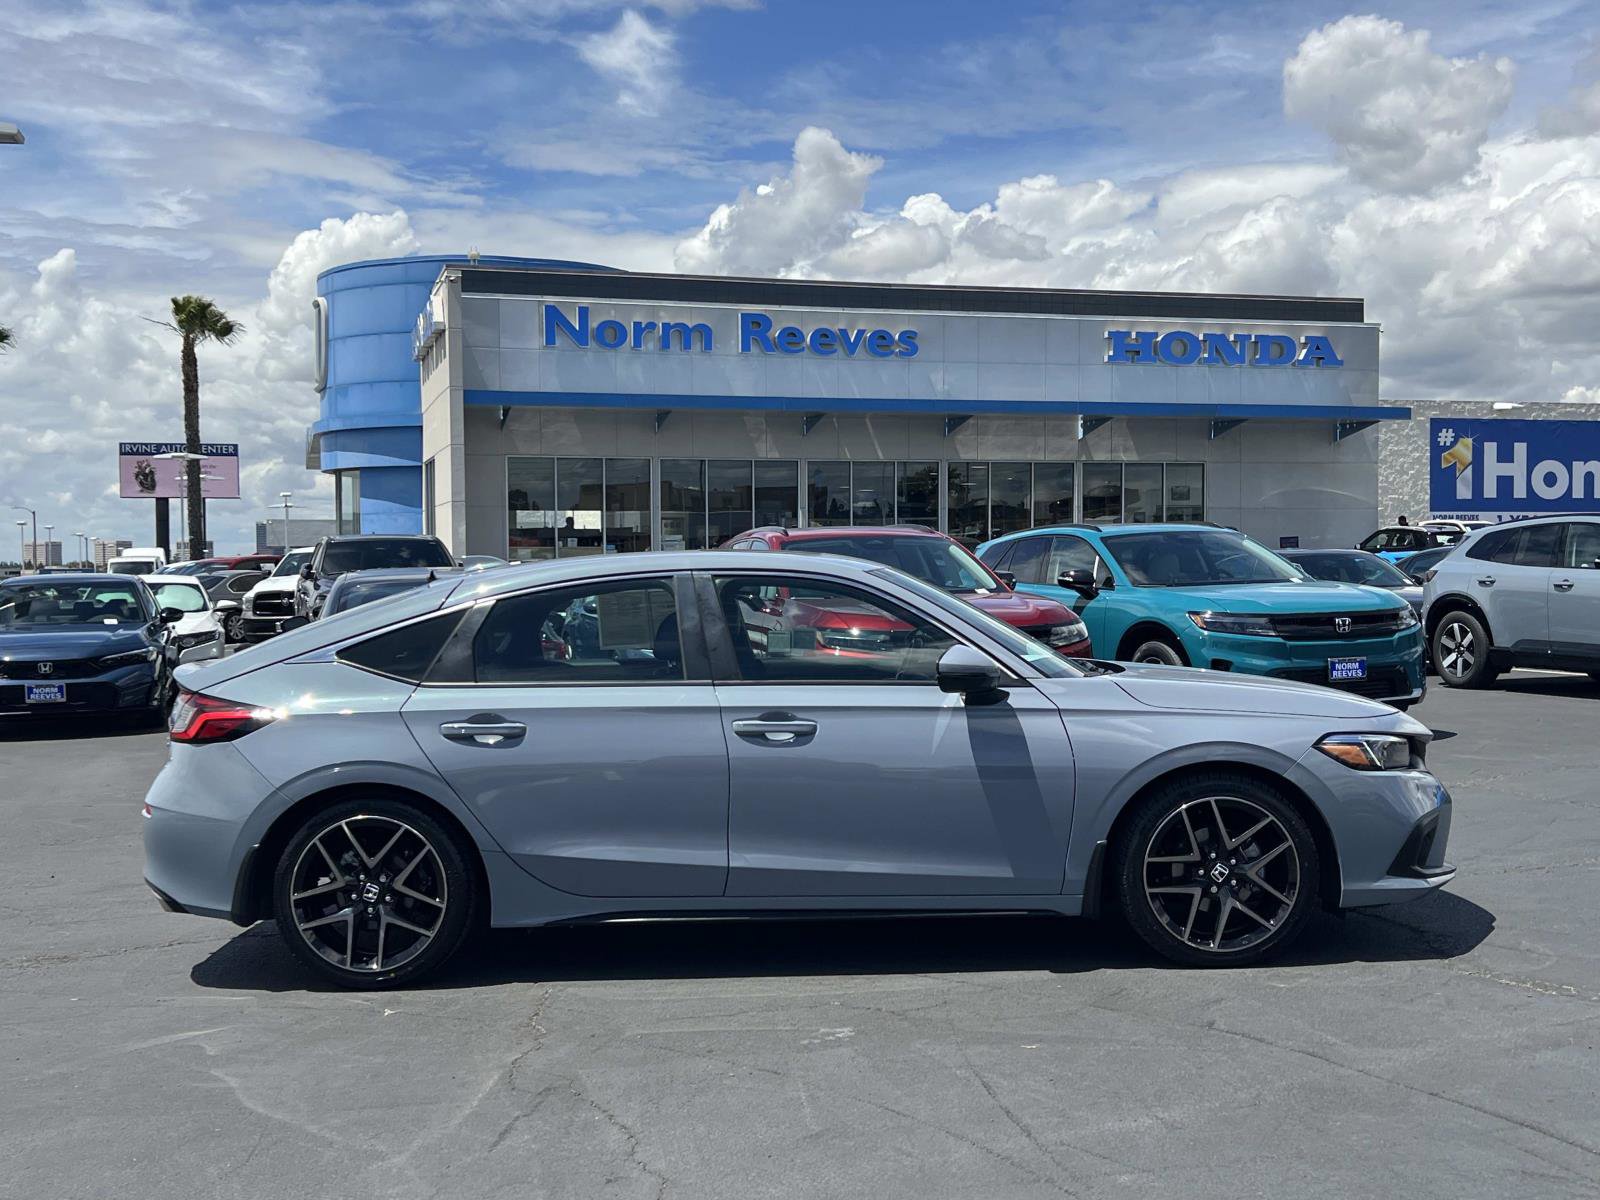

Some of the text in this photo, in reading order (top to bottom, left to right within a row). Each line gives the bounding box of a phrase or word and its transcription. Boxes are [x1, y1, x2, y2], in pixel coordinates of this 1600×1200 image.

[543, 304, 919, 358] Norm Reeves
[1104, 331, 1344, 367] HONDA
[121, 444, 157, 453] IRVINE
[201, 446, 235, 454] ENTER
[1335, 662, 1359, 670] NORM
[1332, 669, 1363, 678] REEVES
[30, 692, 62, 700] REEVES
